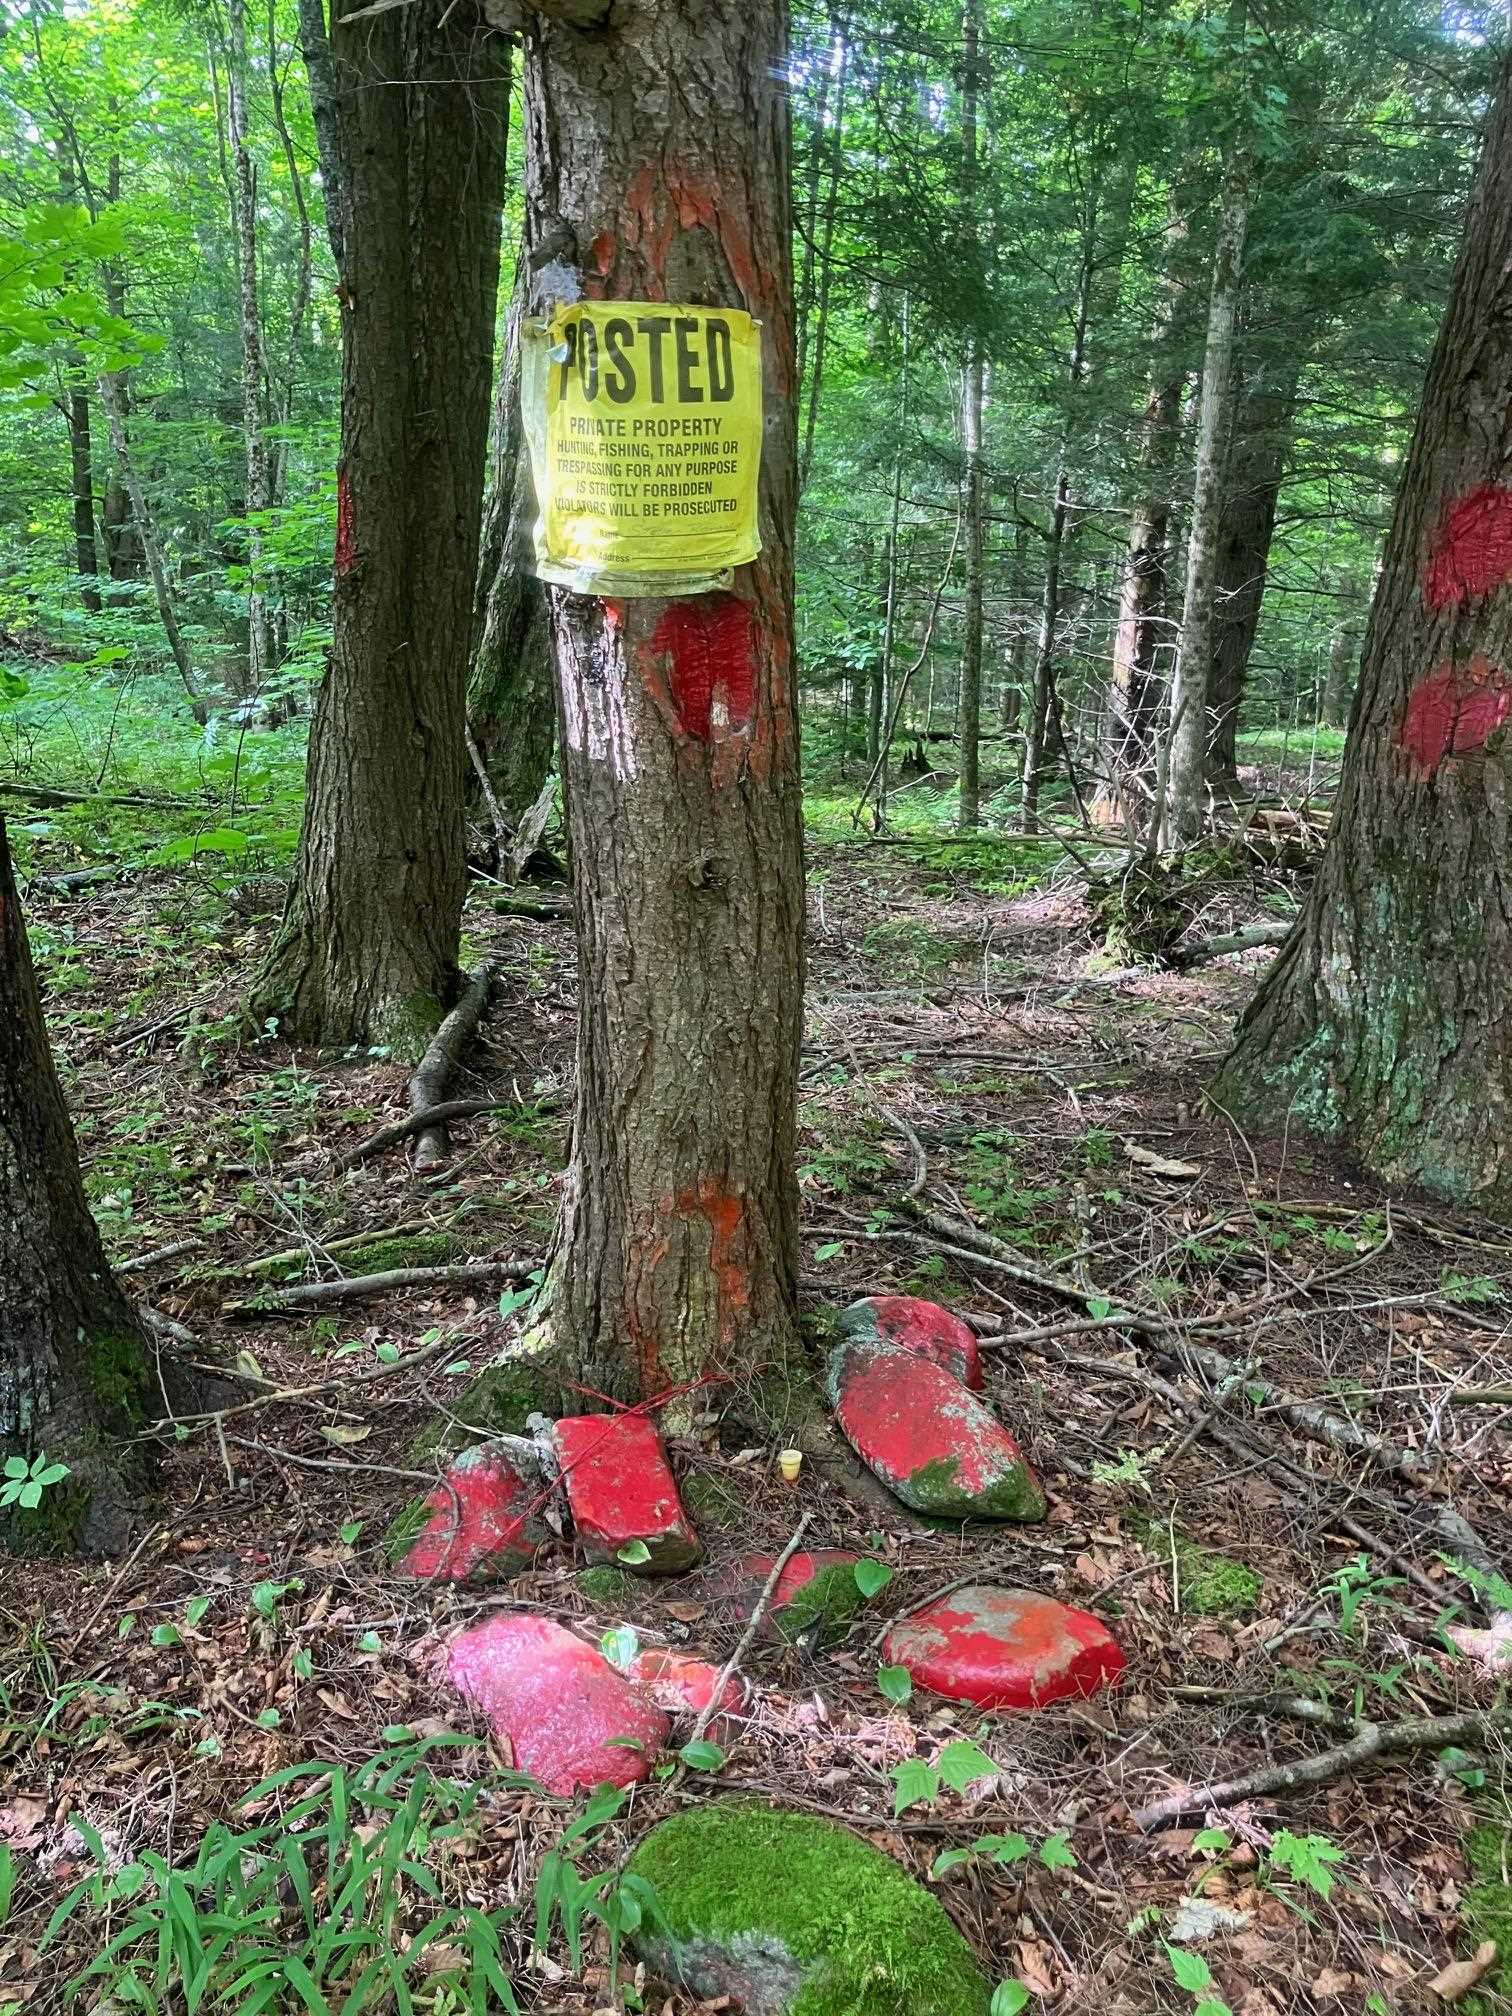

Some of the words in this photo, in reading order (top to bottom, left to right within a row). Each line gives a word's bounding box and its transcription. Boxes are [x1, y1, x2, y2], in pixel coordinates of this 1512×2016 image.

[559, 317, 734, 404] POSTED
[570, 417, 626, 437] PRIVATE
[632, 418, 722, 437] PROPERTY
[557, 440, 597, 457] HUNTING,
[599, 443, 653, 459] FISHING,
[657, 442, 719, 457] TRAPPING
[723, 441, 738, 454] OR
[557, 459, 621, 477] TRESPASSING
[626, 464, 651, 477] FOR
[656, 464, 681, 477] ANY
[686, 460, 737, 476] PURPOSE
[576, 481, 586, 494] IS
[589, 482, 638, 497] STRICTLY
[643, 481, 712, 497] FORBIDDEN
[555, 497, 606, 515] VIOLATORS
[609, 504, 639, 517] WILL
[643, 504, 659, 516] BE
[664, 498, 737, 516] PROSECUTED
